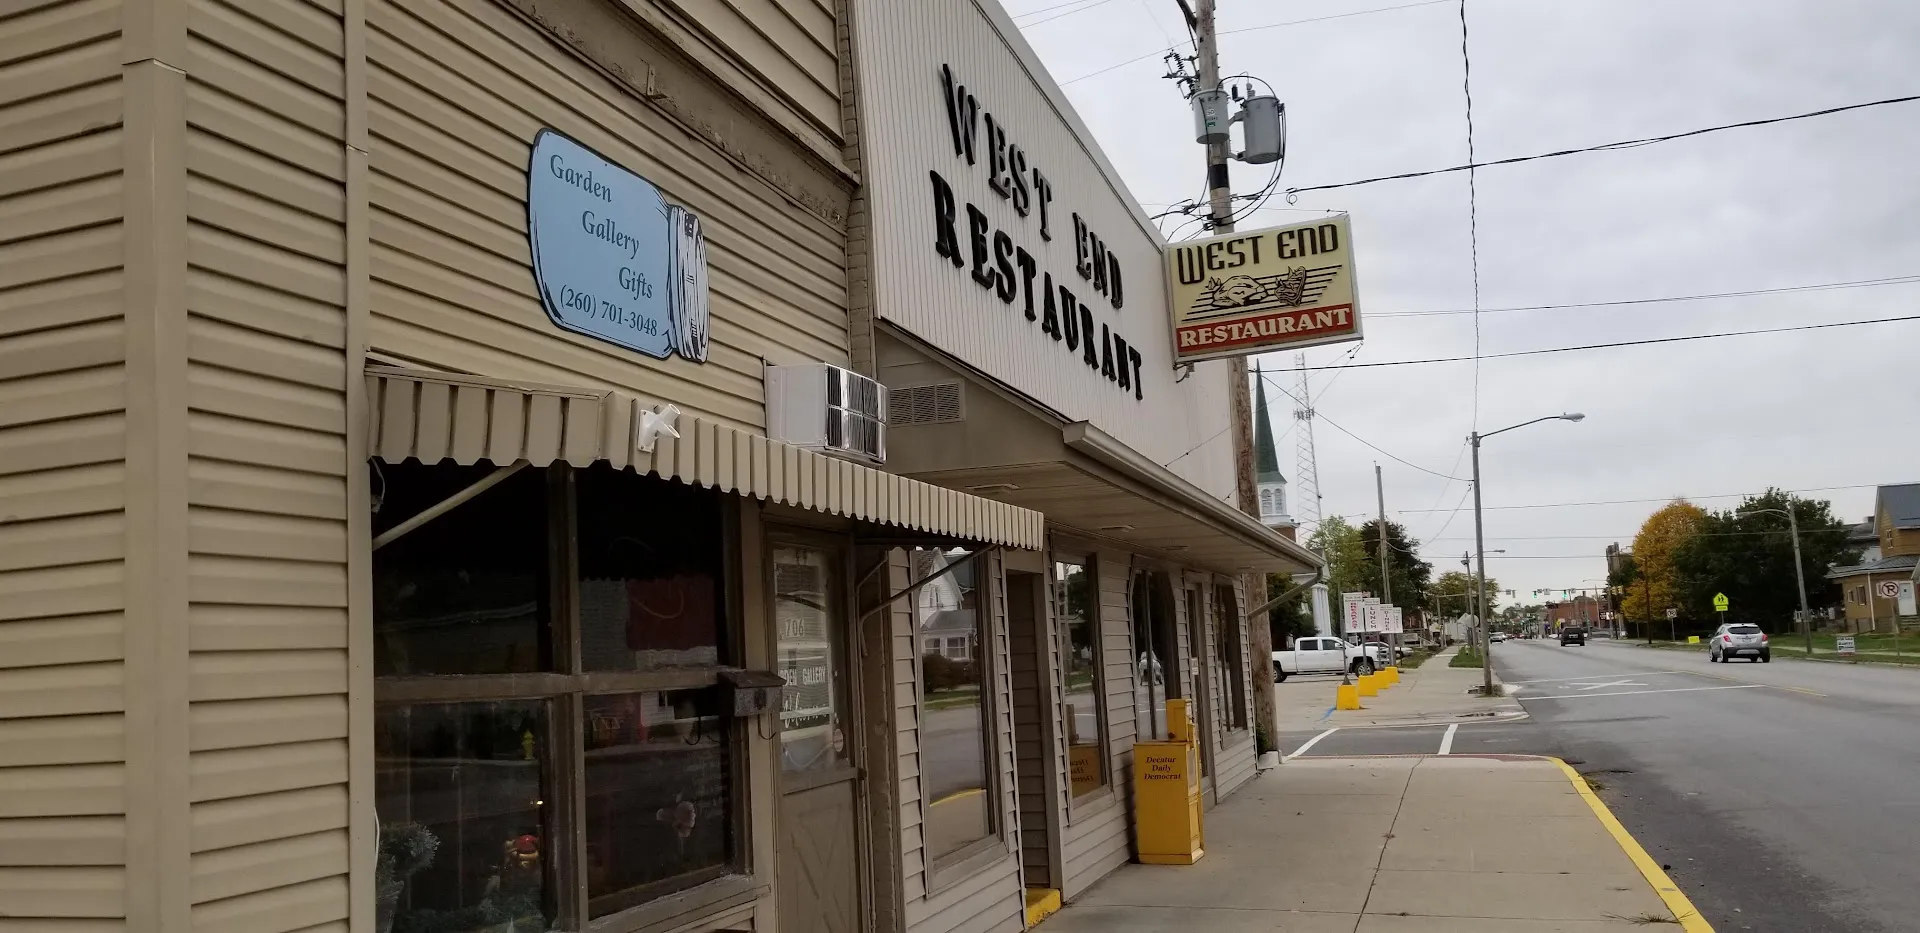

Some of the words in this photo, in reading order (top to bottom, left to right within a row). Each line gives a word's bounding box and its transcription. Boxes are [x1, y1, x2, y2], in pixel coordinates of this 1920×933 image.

[550, 154, 612, 203] Garden
[939, 63, 1052, 241] WEST
[1072, 212, 1123, 310] END
[582, 210, 640, 259] Gallery
[1177, 235, 1263, 285] WEST
[1277, 223, 1339, 259] END
[618, 266, 653, 300] Gifts
[929, 169, 1143, 401] RESTAURANT
[560, 284, 597, 319] (260)
[601, 300, 658, 337] 701-3048
[1179, 307, 1350, 347] RESTAURANT
[802, 666, 826, 685] GALLERY
[1152, 764, 1171, 772] Daily
